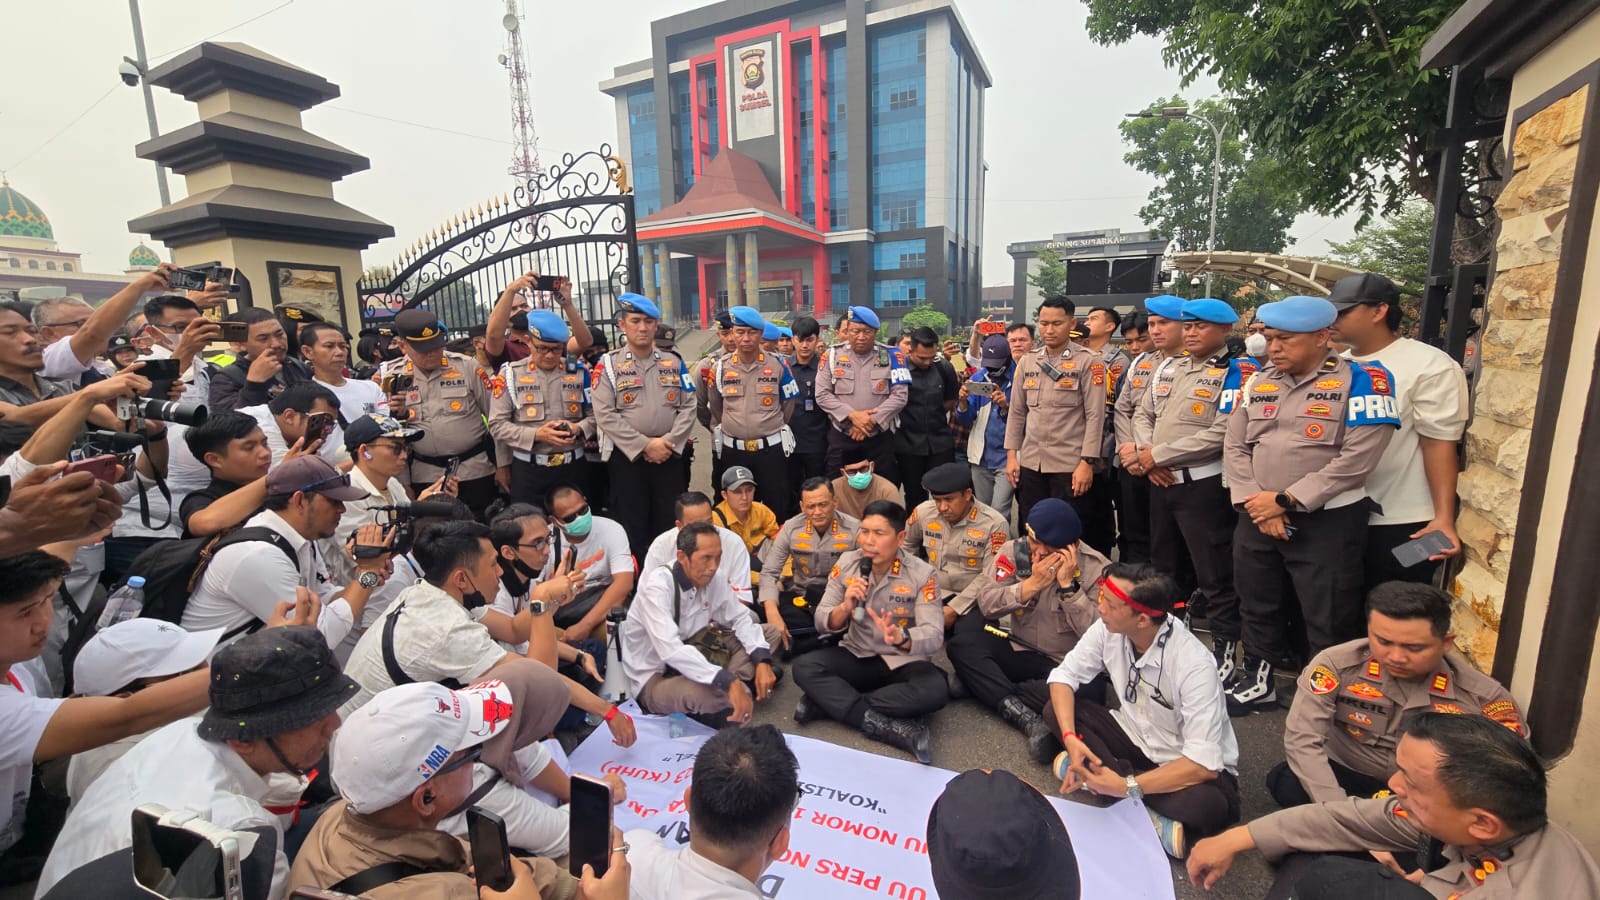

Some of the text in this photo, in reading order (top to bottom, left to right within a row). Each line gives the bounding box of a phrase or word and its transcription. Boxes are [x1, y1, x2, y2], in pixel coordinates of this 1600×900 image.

[440, 379, 466, 388] POLRI
[1196, 378, 1222, 388] POLRI
[1306, 392, 1343, 402] POLRI
[736, 468, 746, 479] E
[961, 538, 986, 548] POLRI
[888, 594, 917, 604] POLRI
[424, 744, 451, 771] NBA
[810, 810, 898, 846] NOMOR
[814, 858, 883, 891] PERS
[887, 881, 927, 900] UU
